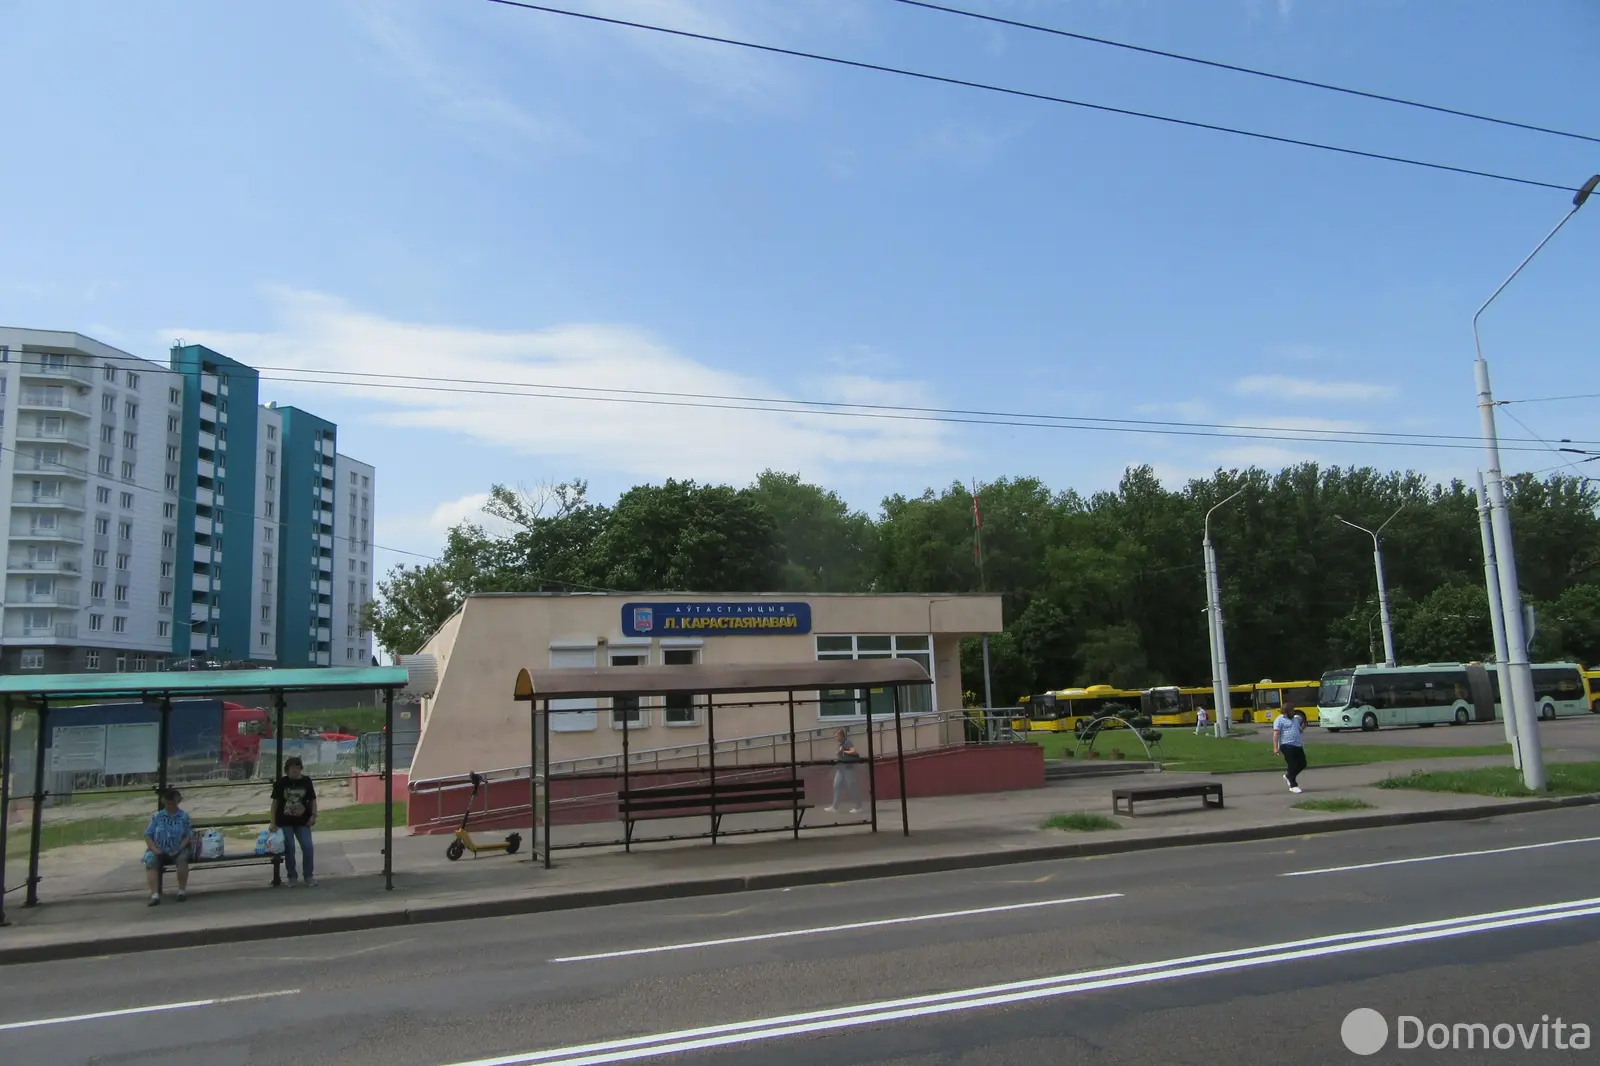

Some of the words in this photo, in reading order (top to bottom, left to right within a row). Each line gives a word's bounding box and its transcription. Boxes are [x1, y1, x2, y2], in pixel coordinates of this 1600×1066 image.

[675, 605, 785, 613] АЎТАСТАНЦЫЯ
[663, 617, 680, 629] Л.
[681, 613, 798, 629] КАРАСТАЯНАВАЙ
